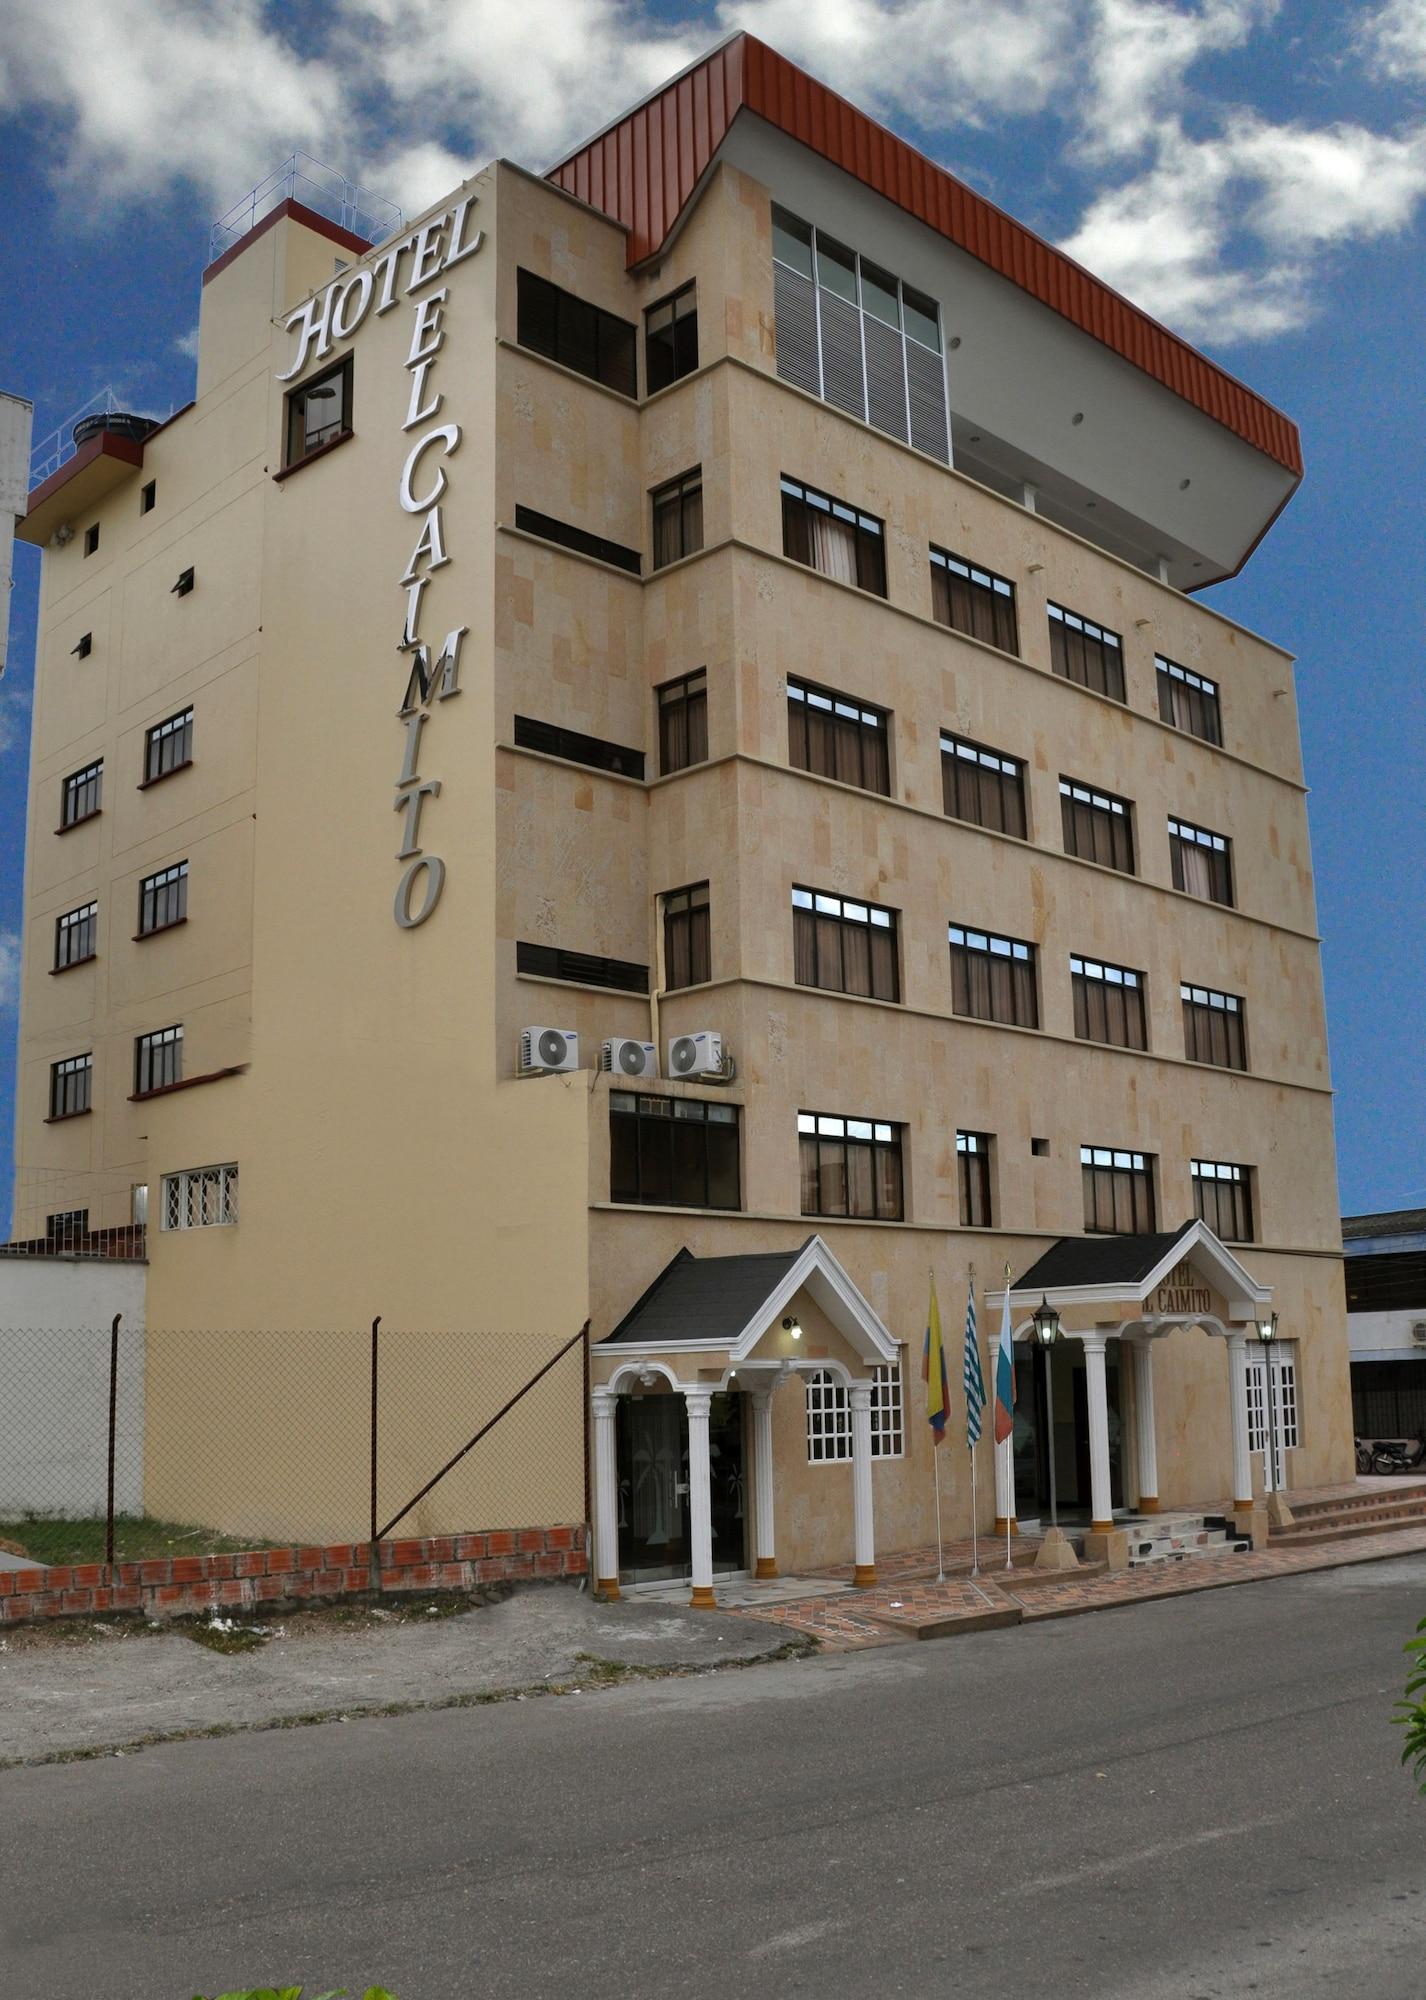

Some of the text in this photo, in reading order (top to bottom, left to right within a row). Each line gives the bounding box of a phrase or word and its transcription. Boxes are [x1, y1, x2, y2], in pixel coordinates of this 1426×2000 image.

[275, 194, 485, 382] HOTEL
[393, 288, 469, 930] EL CAIMITO
[1158, 1288, 1211, 1312] CAIMITO
[1160, 1263, 1194, 1287] OTEL
